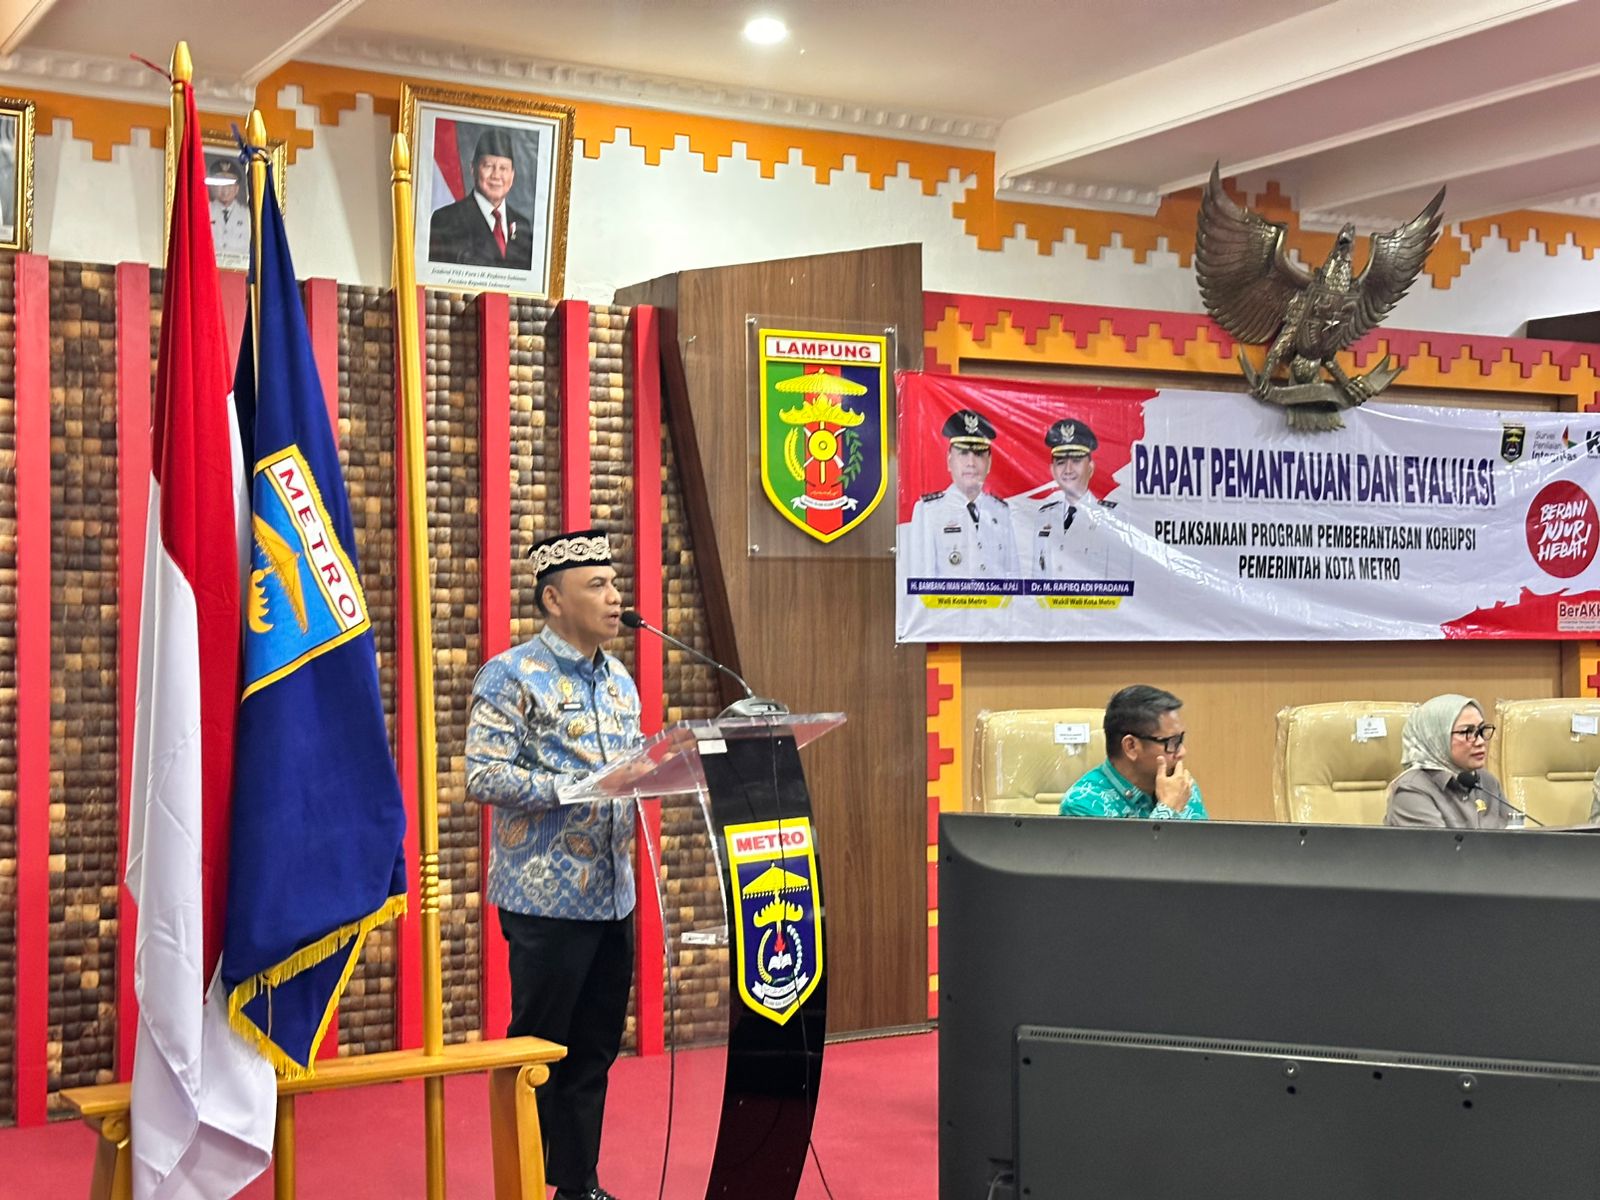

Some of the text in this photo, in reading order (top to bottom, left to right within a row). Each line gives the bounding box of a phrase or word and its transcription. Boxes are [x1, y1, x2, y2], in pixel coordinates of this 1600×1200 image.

[776, 340, 871, 359] LAMPUNG
[1135, 443, 1496, 506] RAPAT PEMANTAUAN DAN EVALUASI
[1540, 499, 1588, 523] BERANI
[278, 468, 356, 618] METRO
[1155, 520, 1476, 551] PELAKSANAAN PROGRAM PEMBERANTASAN KORUPSI
[1535, 520, 1585, 545] JUJUR
[1239, 555, 1400, 580] PEMERINTAH KOTA METRO
[1031, 582, 1129, 593] Dr. M. RAFIEQ ADI PRADANA
[938, 597, 951, 605] Wali
[952, 597, 967, 605] Kota
[736, 830, 805, 854] METRO
